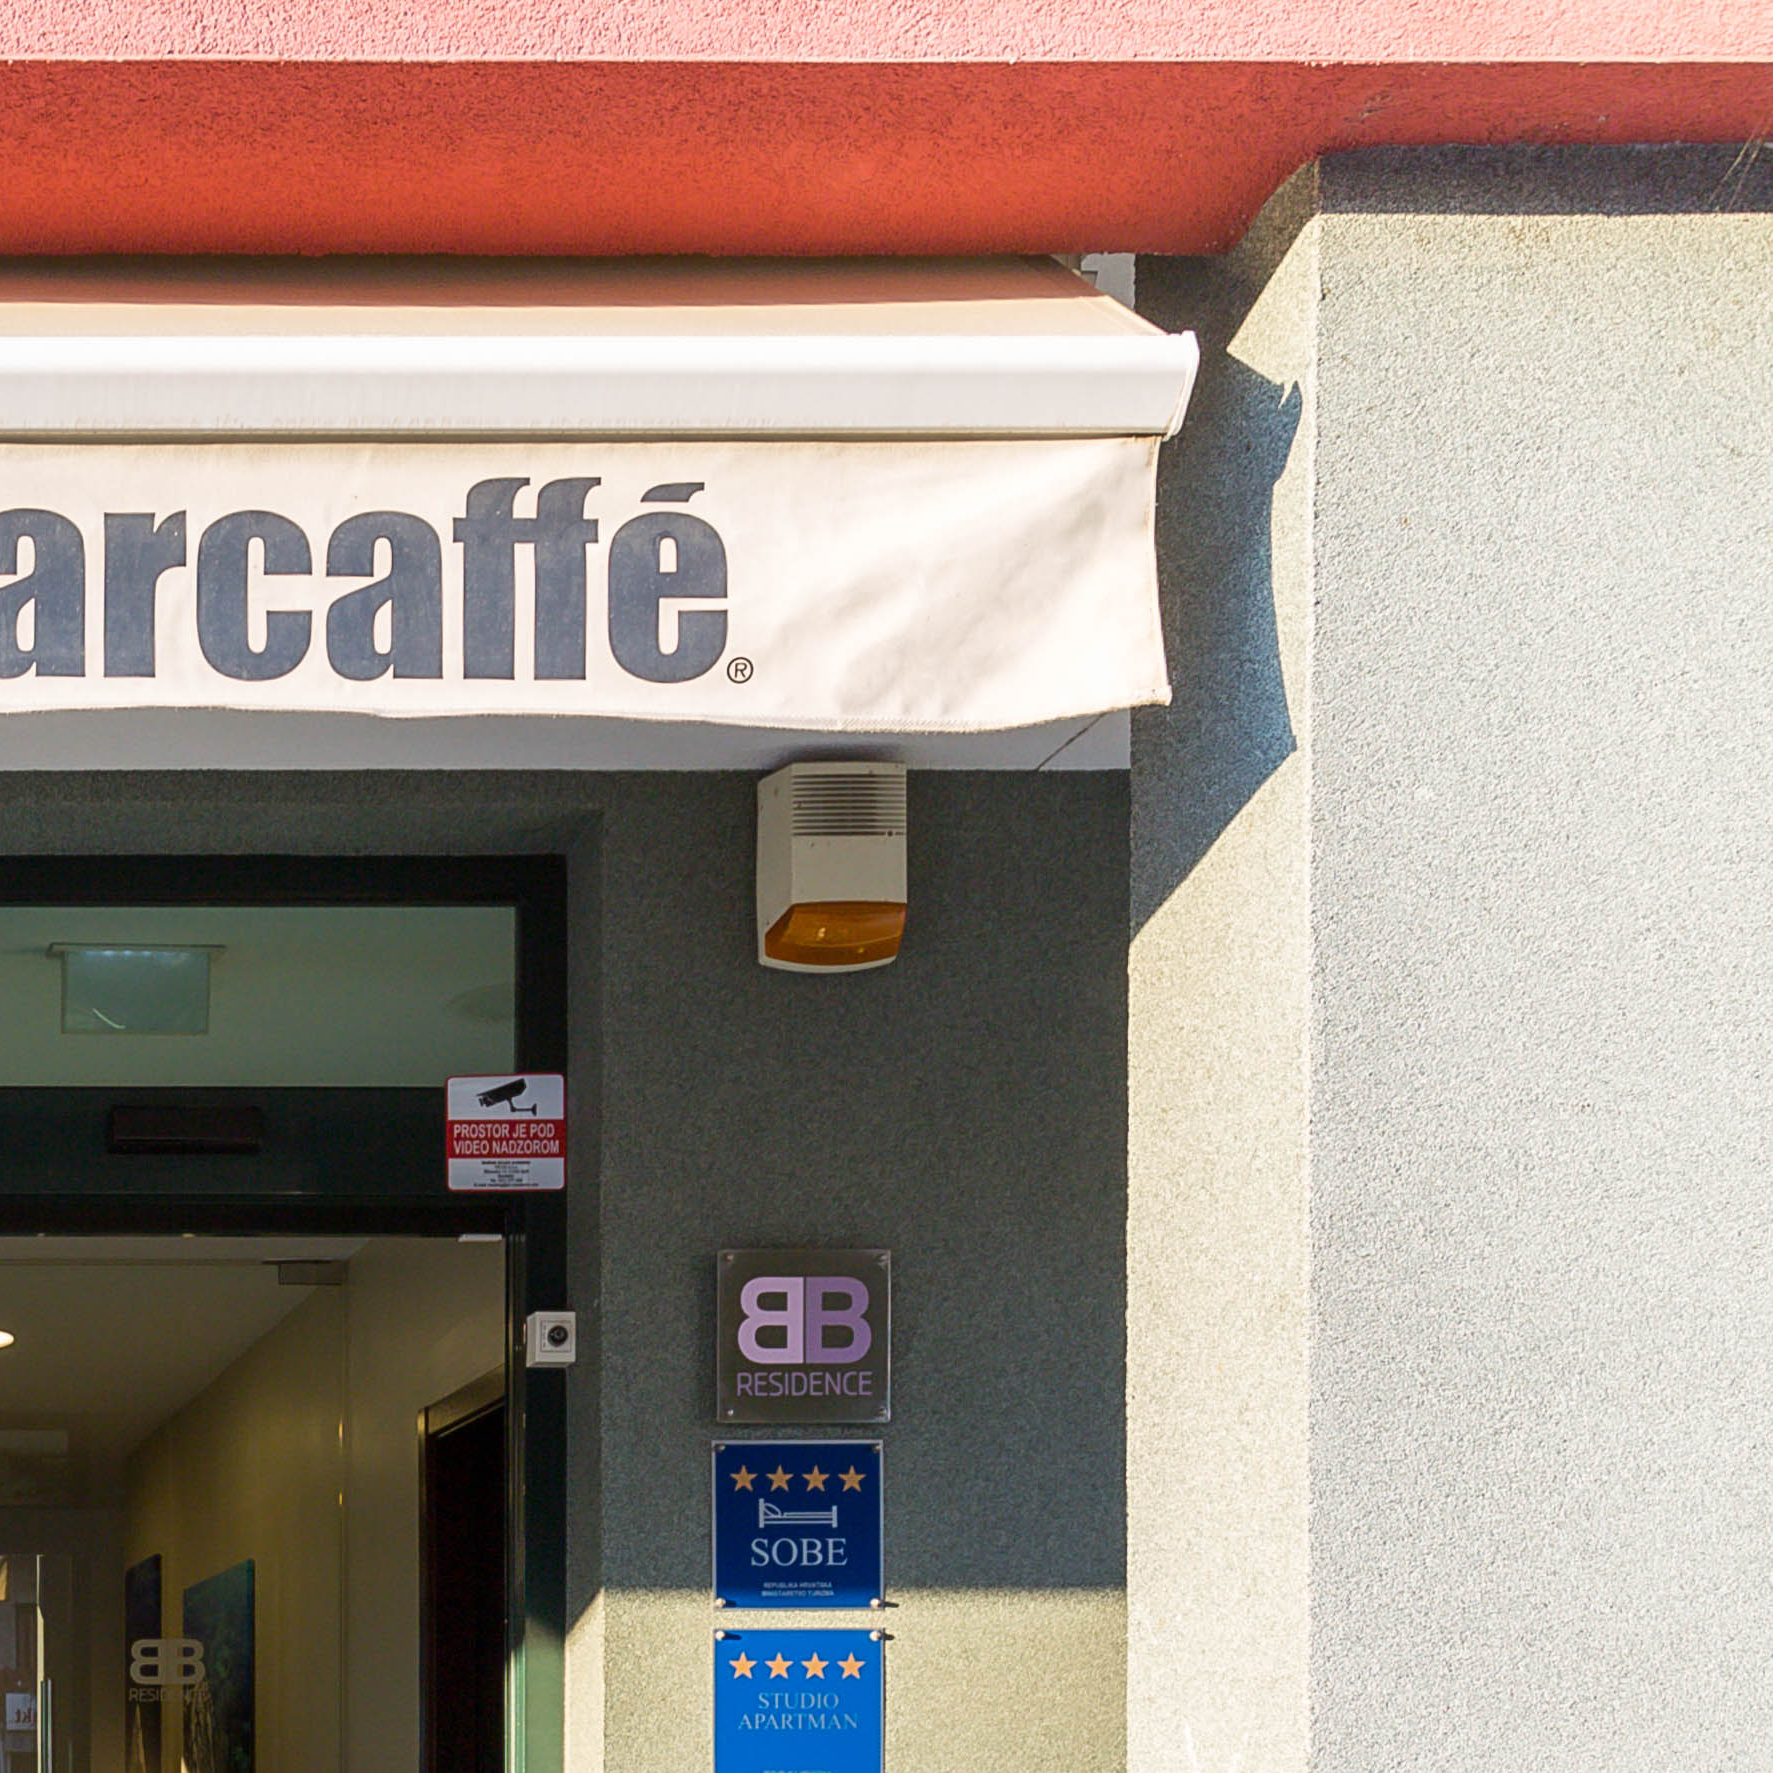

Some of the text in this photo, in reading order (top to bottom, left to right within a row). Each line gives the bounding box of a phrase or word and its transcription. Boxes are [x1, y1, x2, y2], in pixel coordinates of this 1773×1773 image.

[453, 1123, 556, 1138] PROSTOR JE POD
[453, 1140, 560, 1155] VIDEO NADZOROM
[736, 1371, 873, 1397] RESIDENCE
[750, 1537, 848, 1566] SOBE
[758, 1692, 839, 1709] STUDIO
[738, 1714, 858, 1731] APARTMAN
